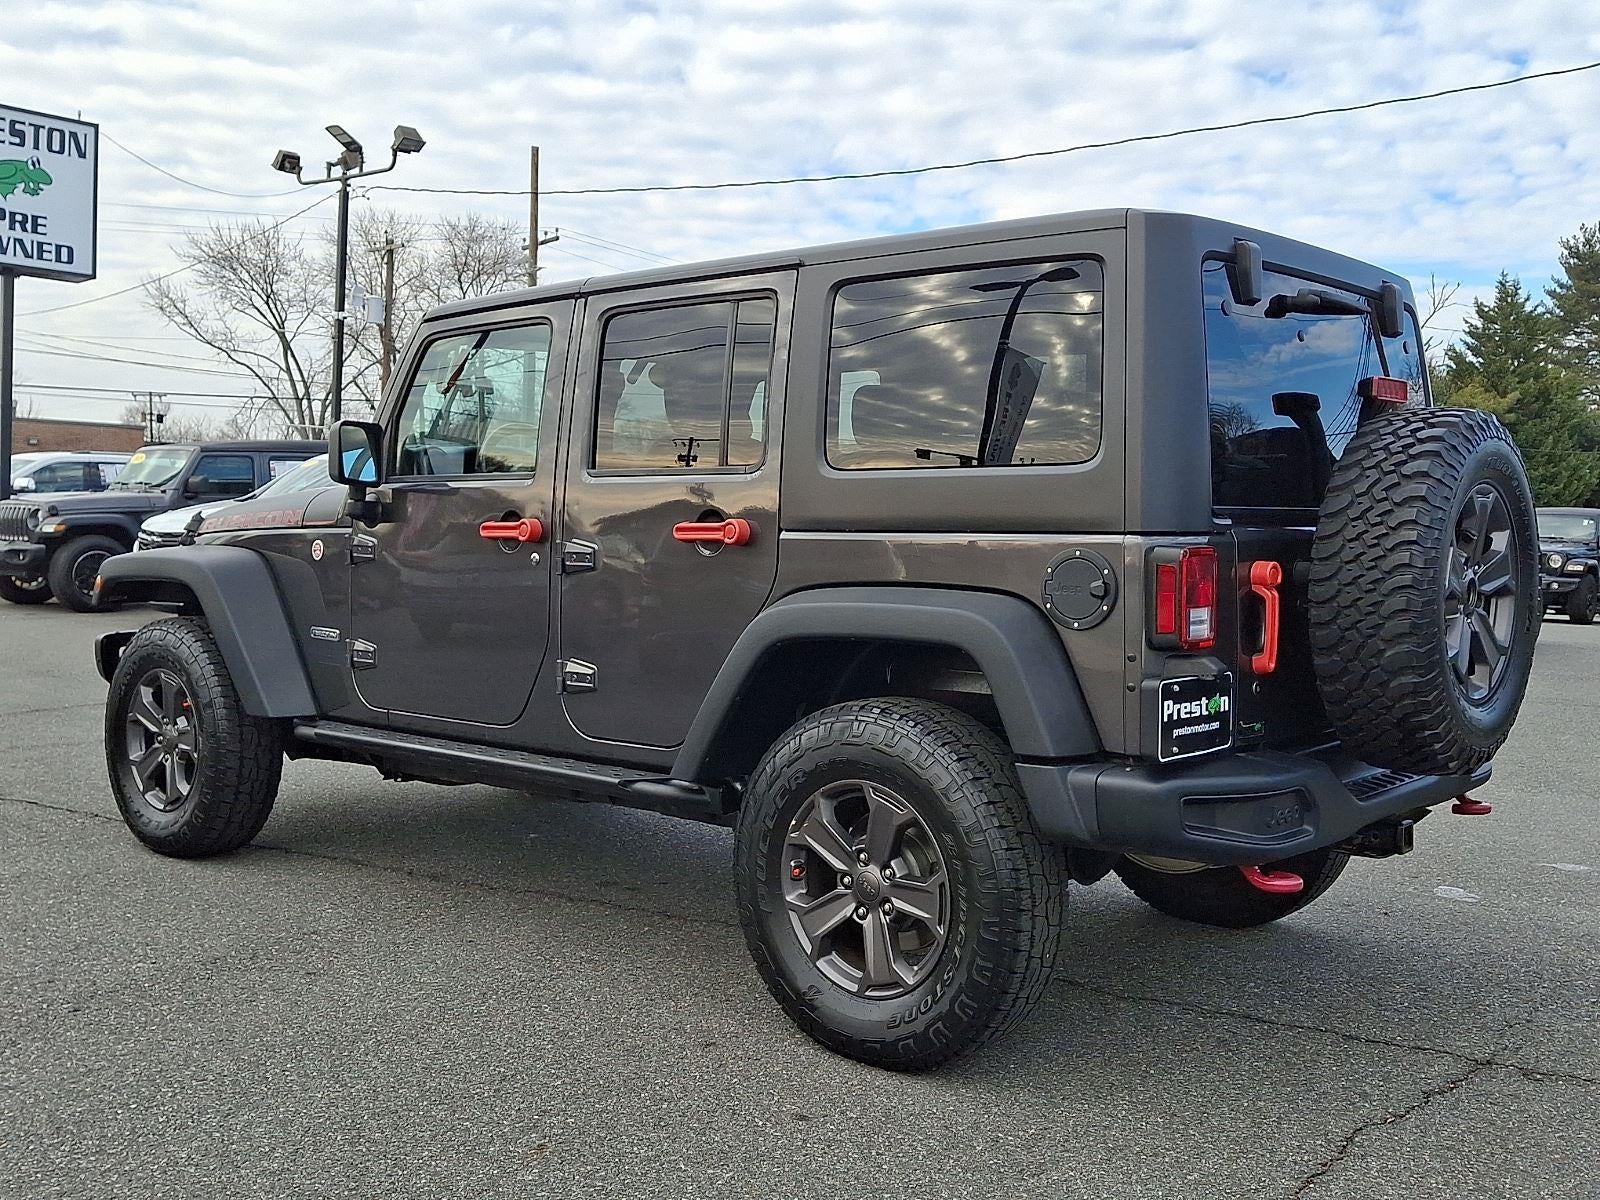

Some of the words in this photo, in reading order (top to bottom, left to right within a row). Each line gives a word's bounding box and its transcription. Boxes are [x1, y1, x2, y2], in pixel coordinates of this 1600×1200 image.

[1163, 694, 1229, 722] Preston
[1172, 721, 1220, 740] prestonmotor.com
[1263, 803, 1301, 830] Jeep
